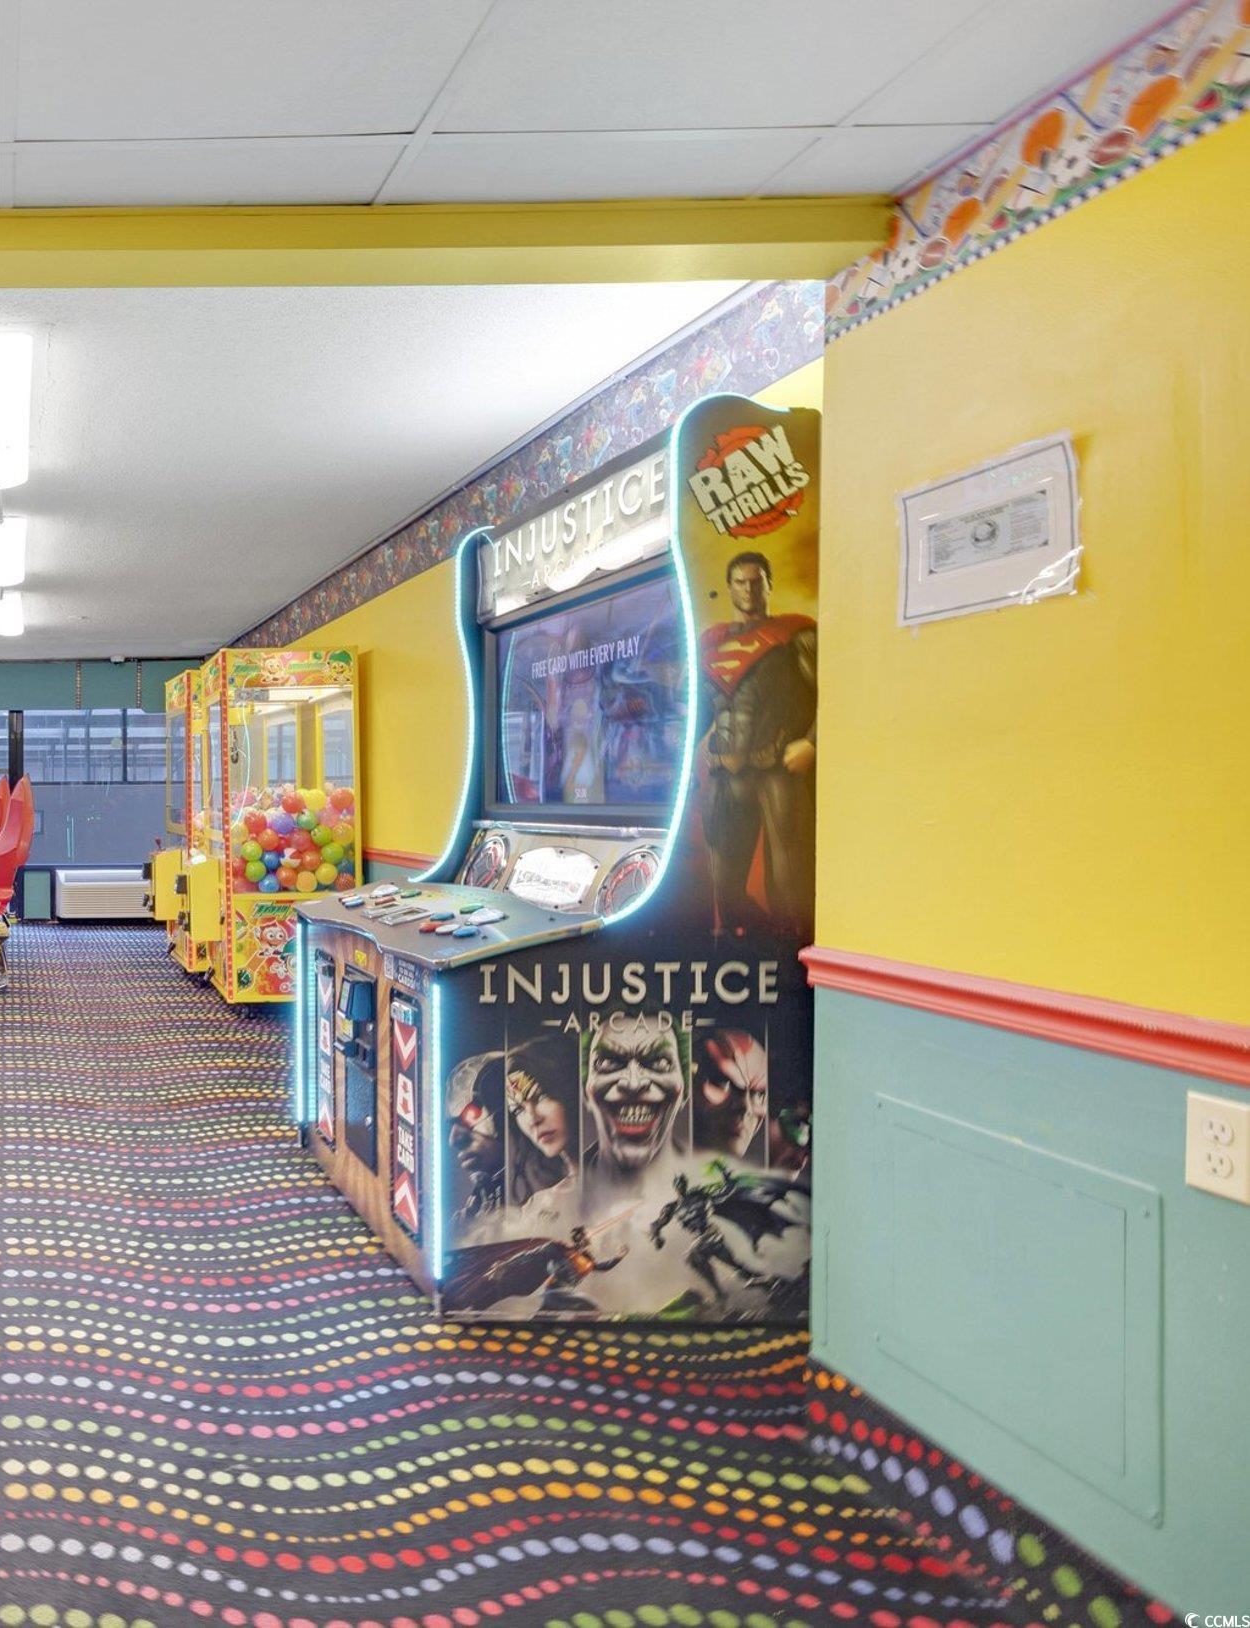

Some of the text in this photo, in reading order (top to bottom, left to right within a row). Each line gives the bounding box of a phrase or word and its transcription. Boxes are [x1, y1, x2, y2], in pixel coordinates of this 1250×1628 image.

[688, 425, 794, 515] RAW
[706, 462, 810, 534] THRILLS
[494, 453, 666, 577] INJUSTICE
[531, 635, 640, 679] FREE CARD WITH EVERY PLAY
[479, 961, 779, 1004] INJUSTICE
[563, 1010, 694, 1033] ARCADE
